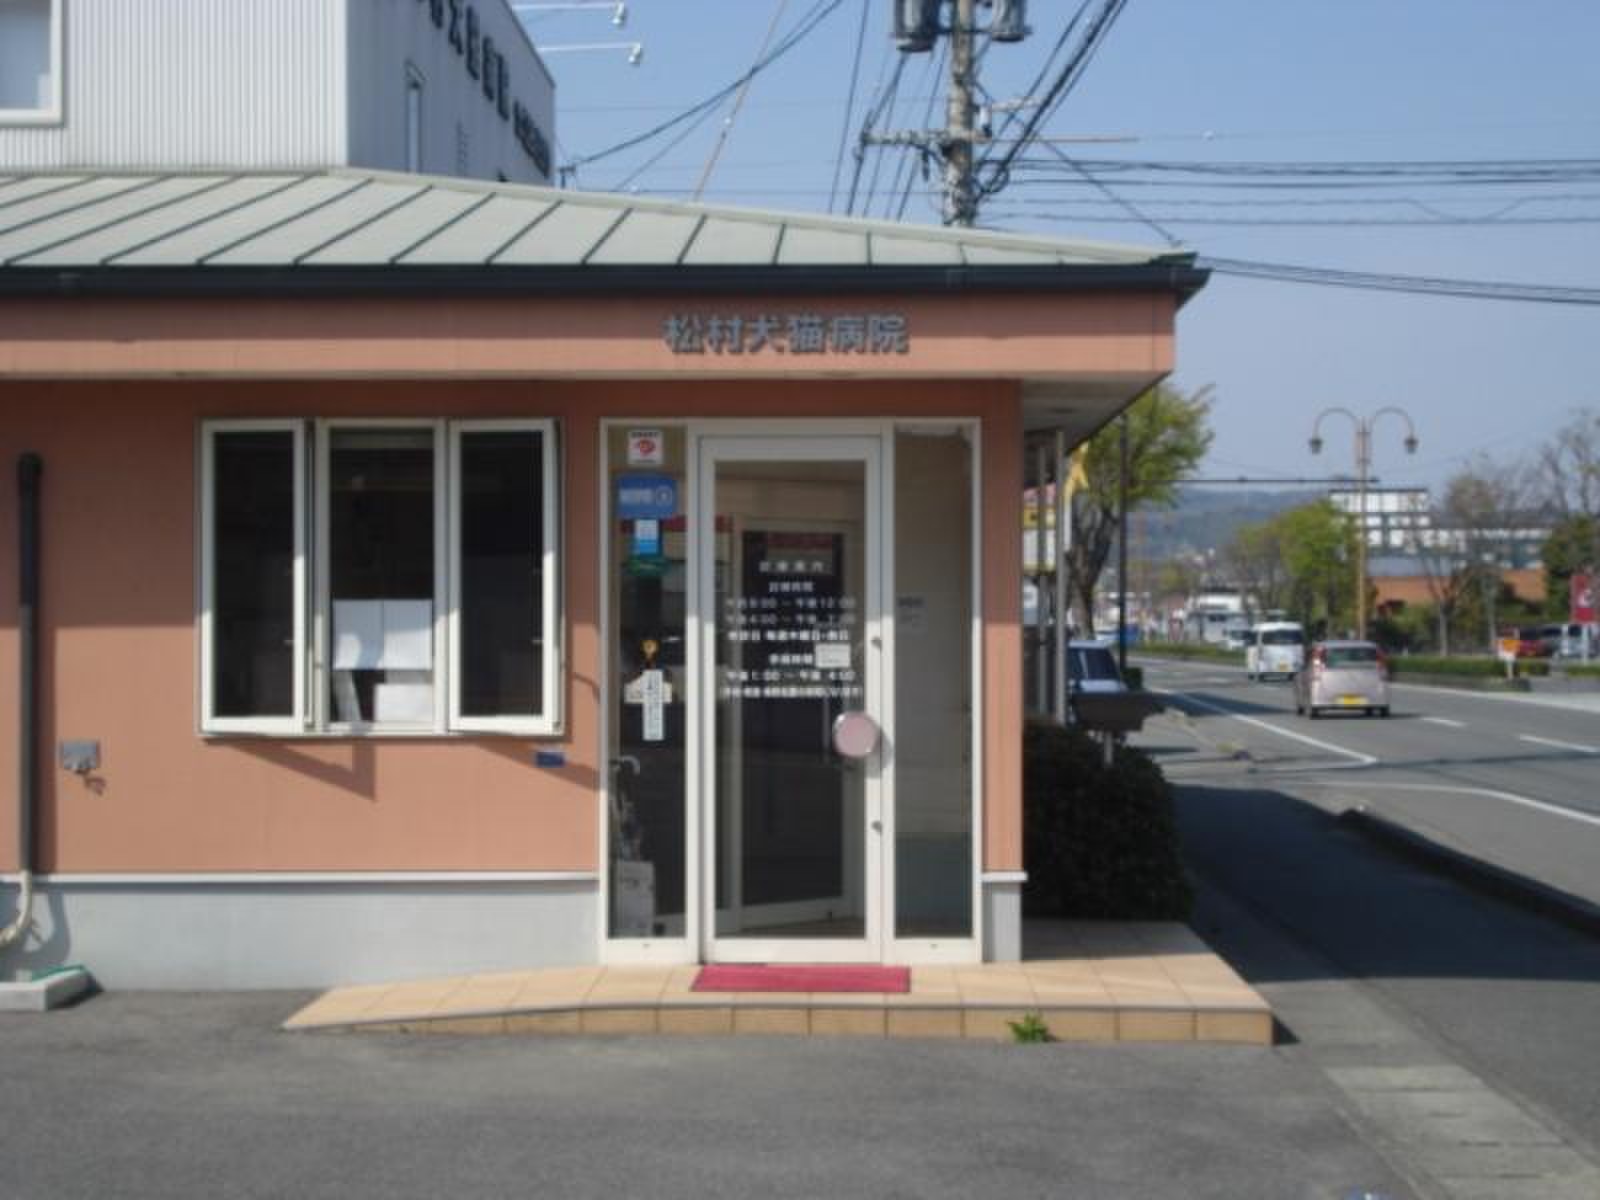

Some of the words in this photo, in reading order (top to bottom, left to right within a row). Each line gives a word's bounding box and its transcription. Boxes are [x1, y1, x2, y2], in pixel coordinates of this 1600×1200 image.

[663, 313, 910, 355] 松村犬猫病院
